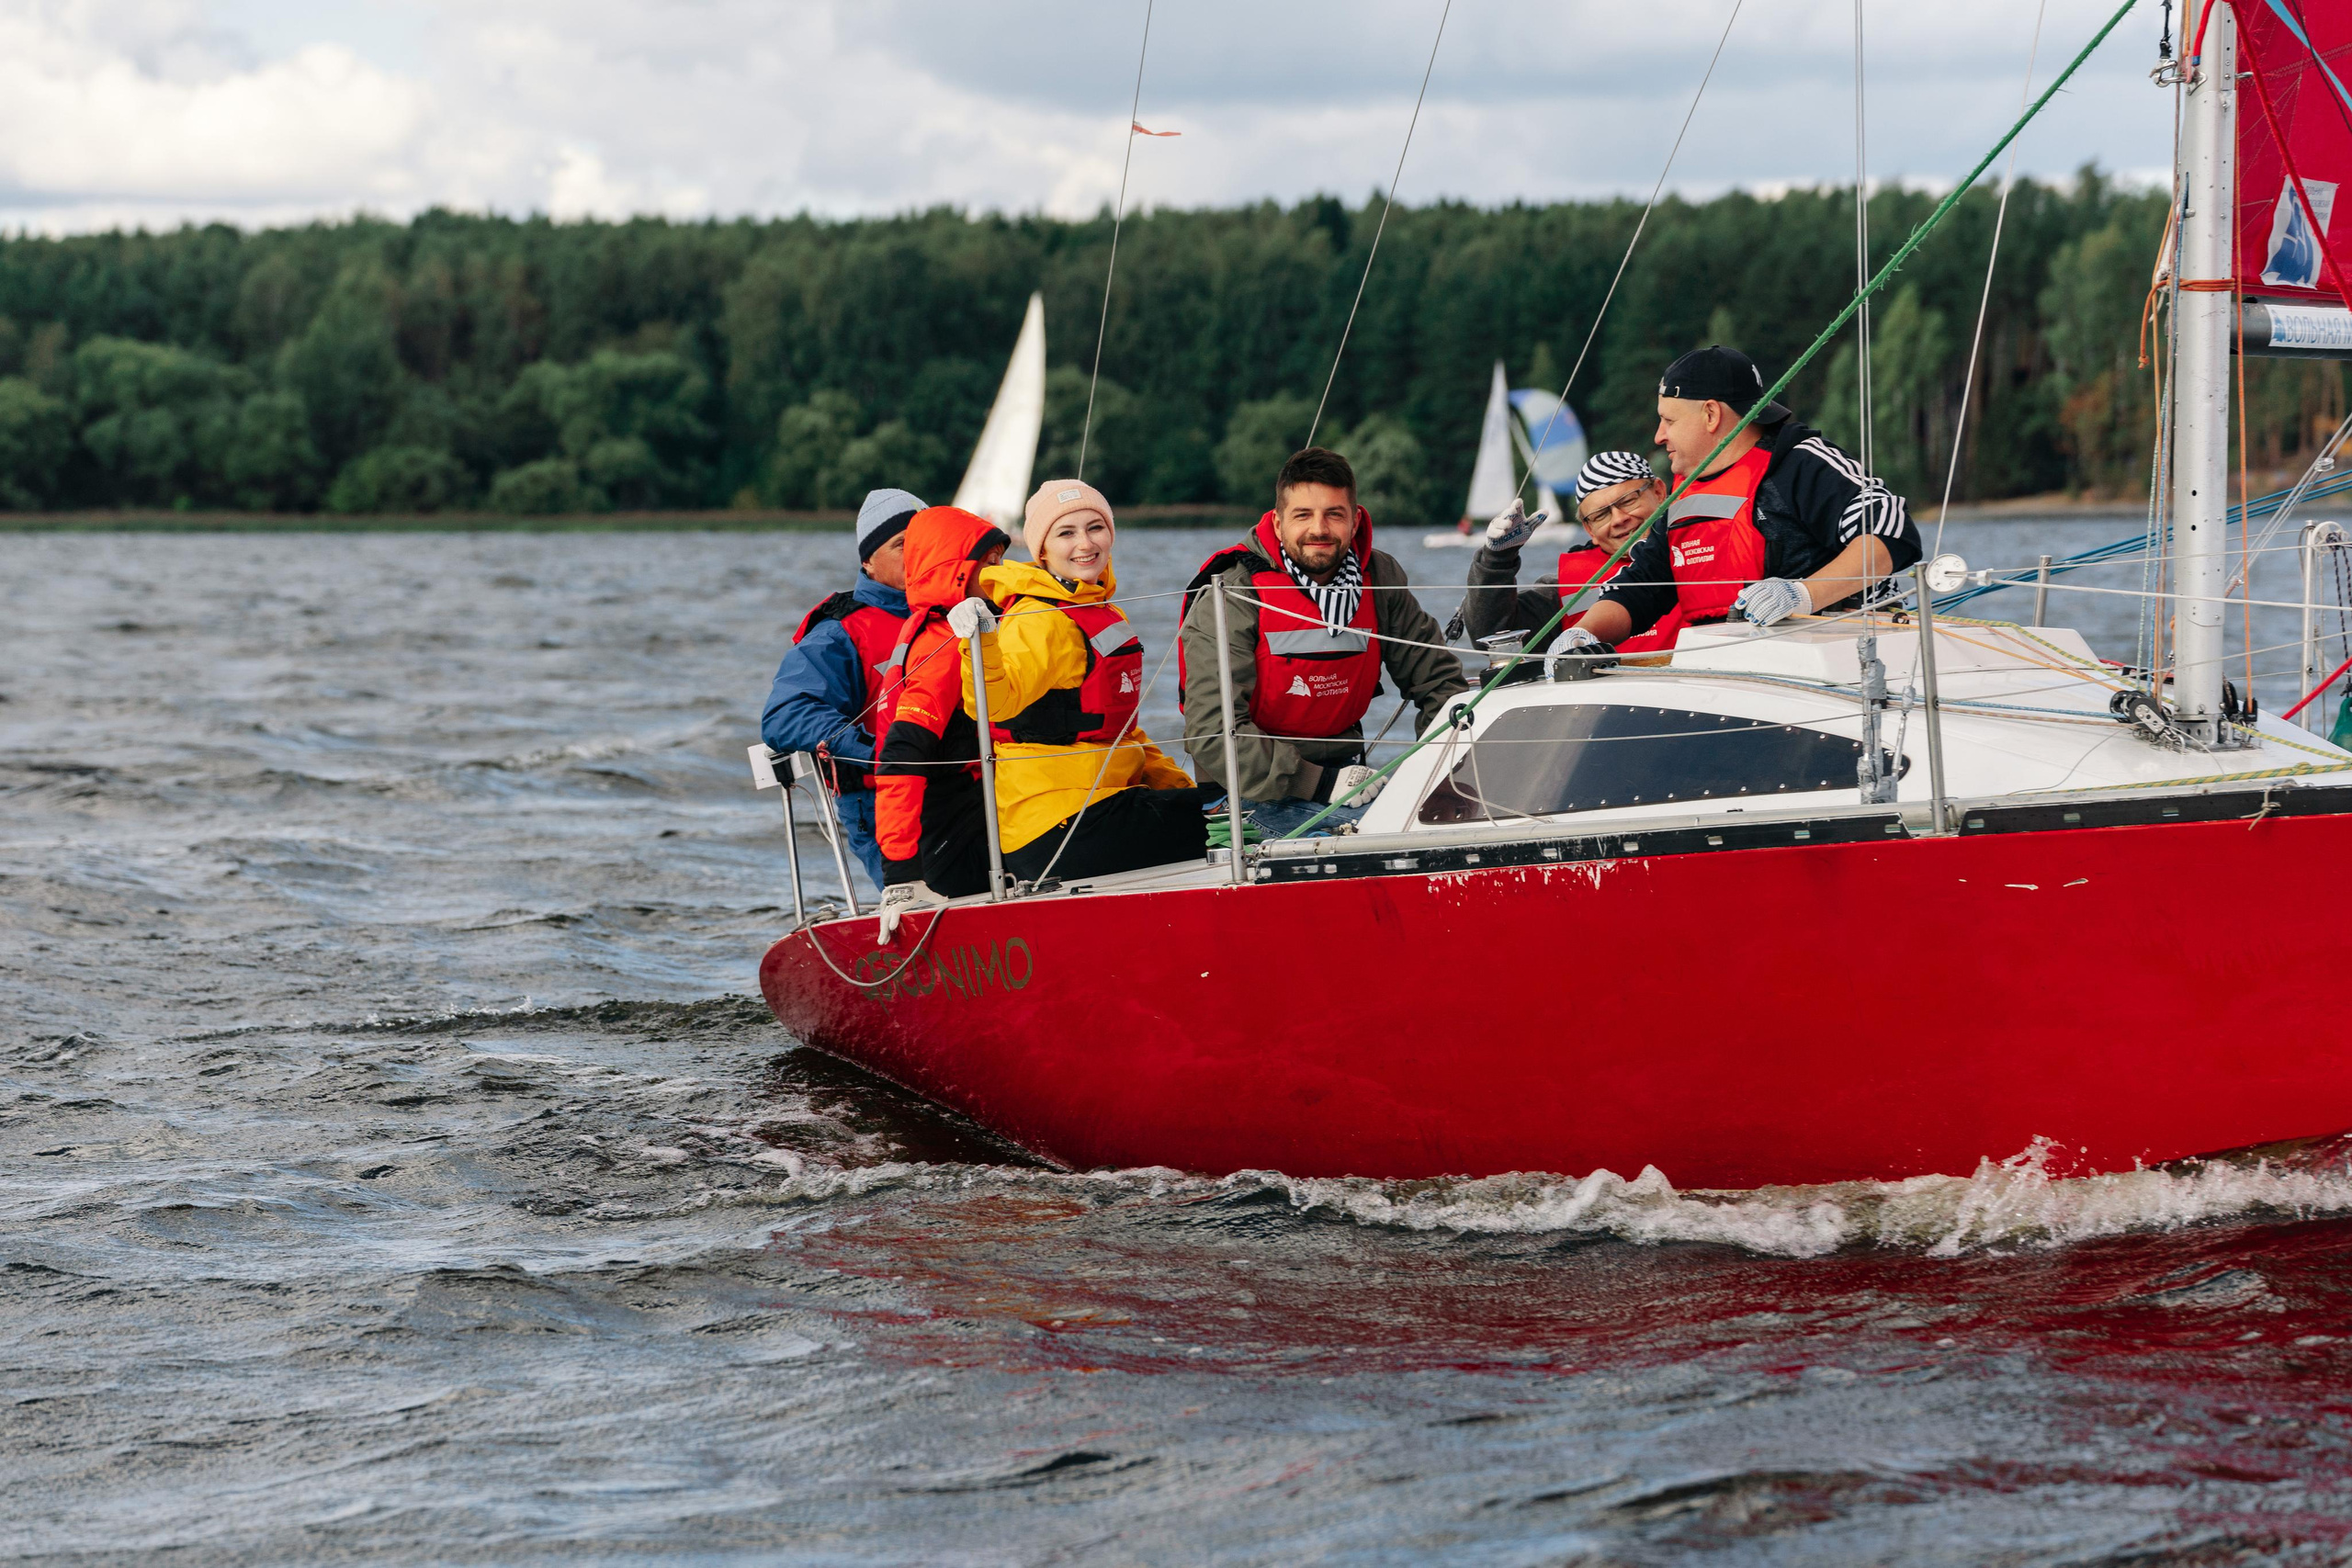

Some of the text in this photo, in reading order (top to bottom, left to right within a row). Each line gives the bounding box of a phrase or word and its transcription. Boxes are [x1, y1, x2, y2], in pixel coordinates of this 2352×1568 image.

[2286, 315, 2341, 344] ВОЛЬНАЯ
[1680, 538, 1701, 549] ВОЛЬНАЯ
[1686, 554, 1714, 566] ФЛОТИЛИЯ
[1308, 672, 1338, 682] ВОЛЬНАЯ
[1313, 679, 1349, 690] МОСКОВСКАЯ
[1316, 686, 1349, 697] ФЛОТИЛИЯ
